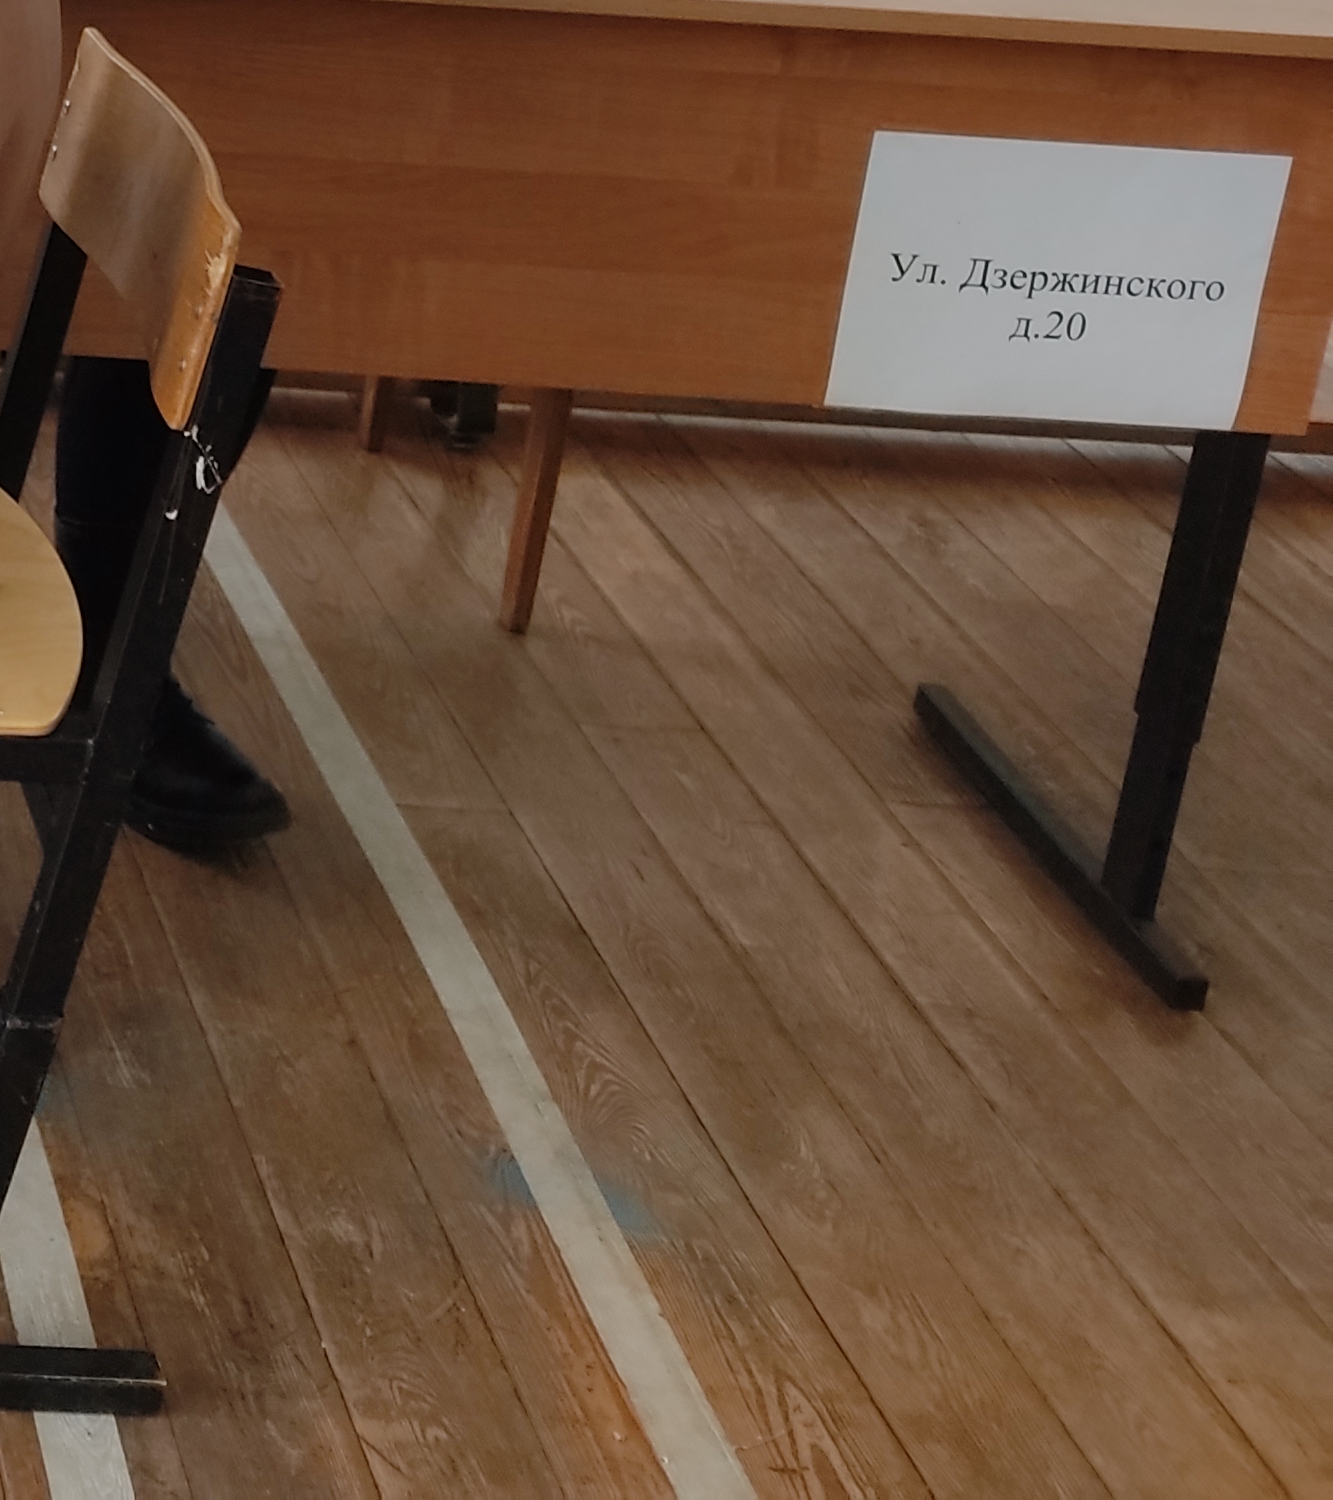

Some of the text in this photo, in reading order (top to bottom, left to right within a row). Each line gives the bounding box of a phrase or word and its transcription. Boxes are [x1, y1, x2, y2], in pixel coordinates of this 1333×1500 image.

[889, 252, 1226, 302] Ул. Дзержинского
[1008, 310, 1088, 344] д.20
